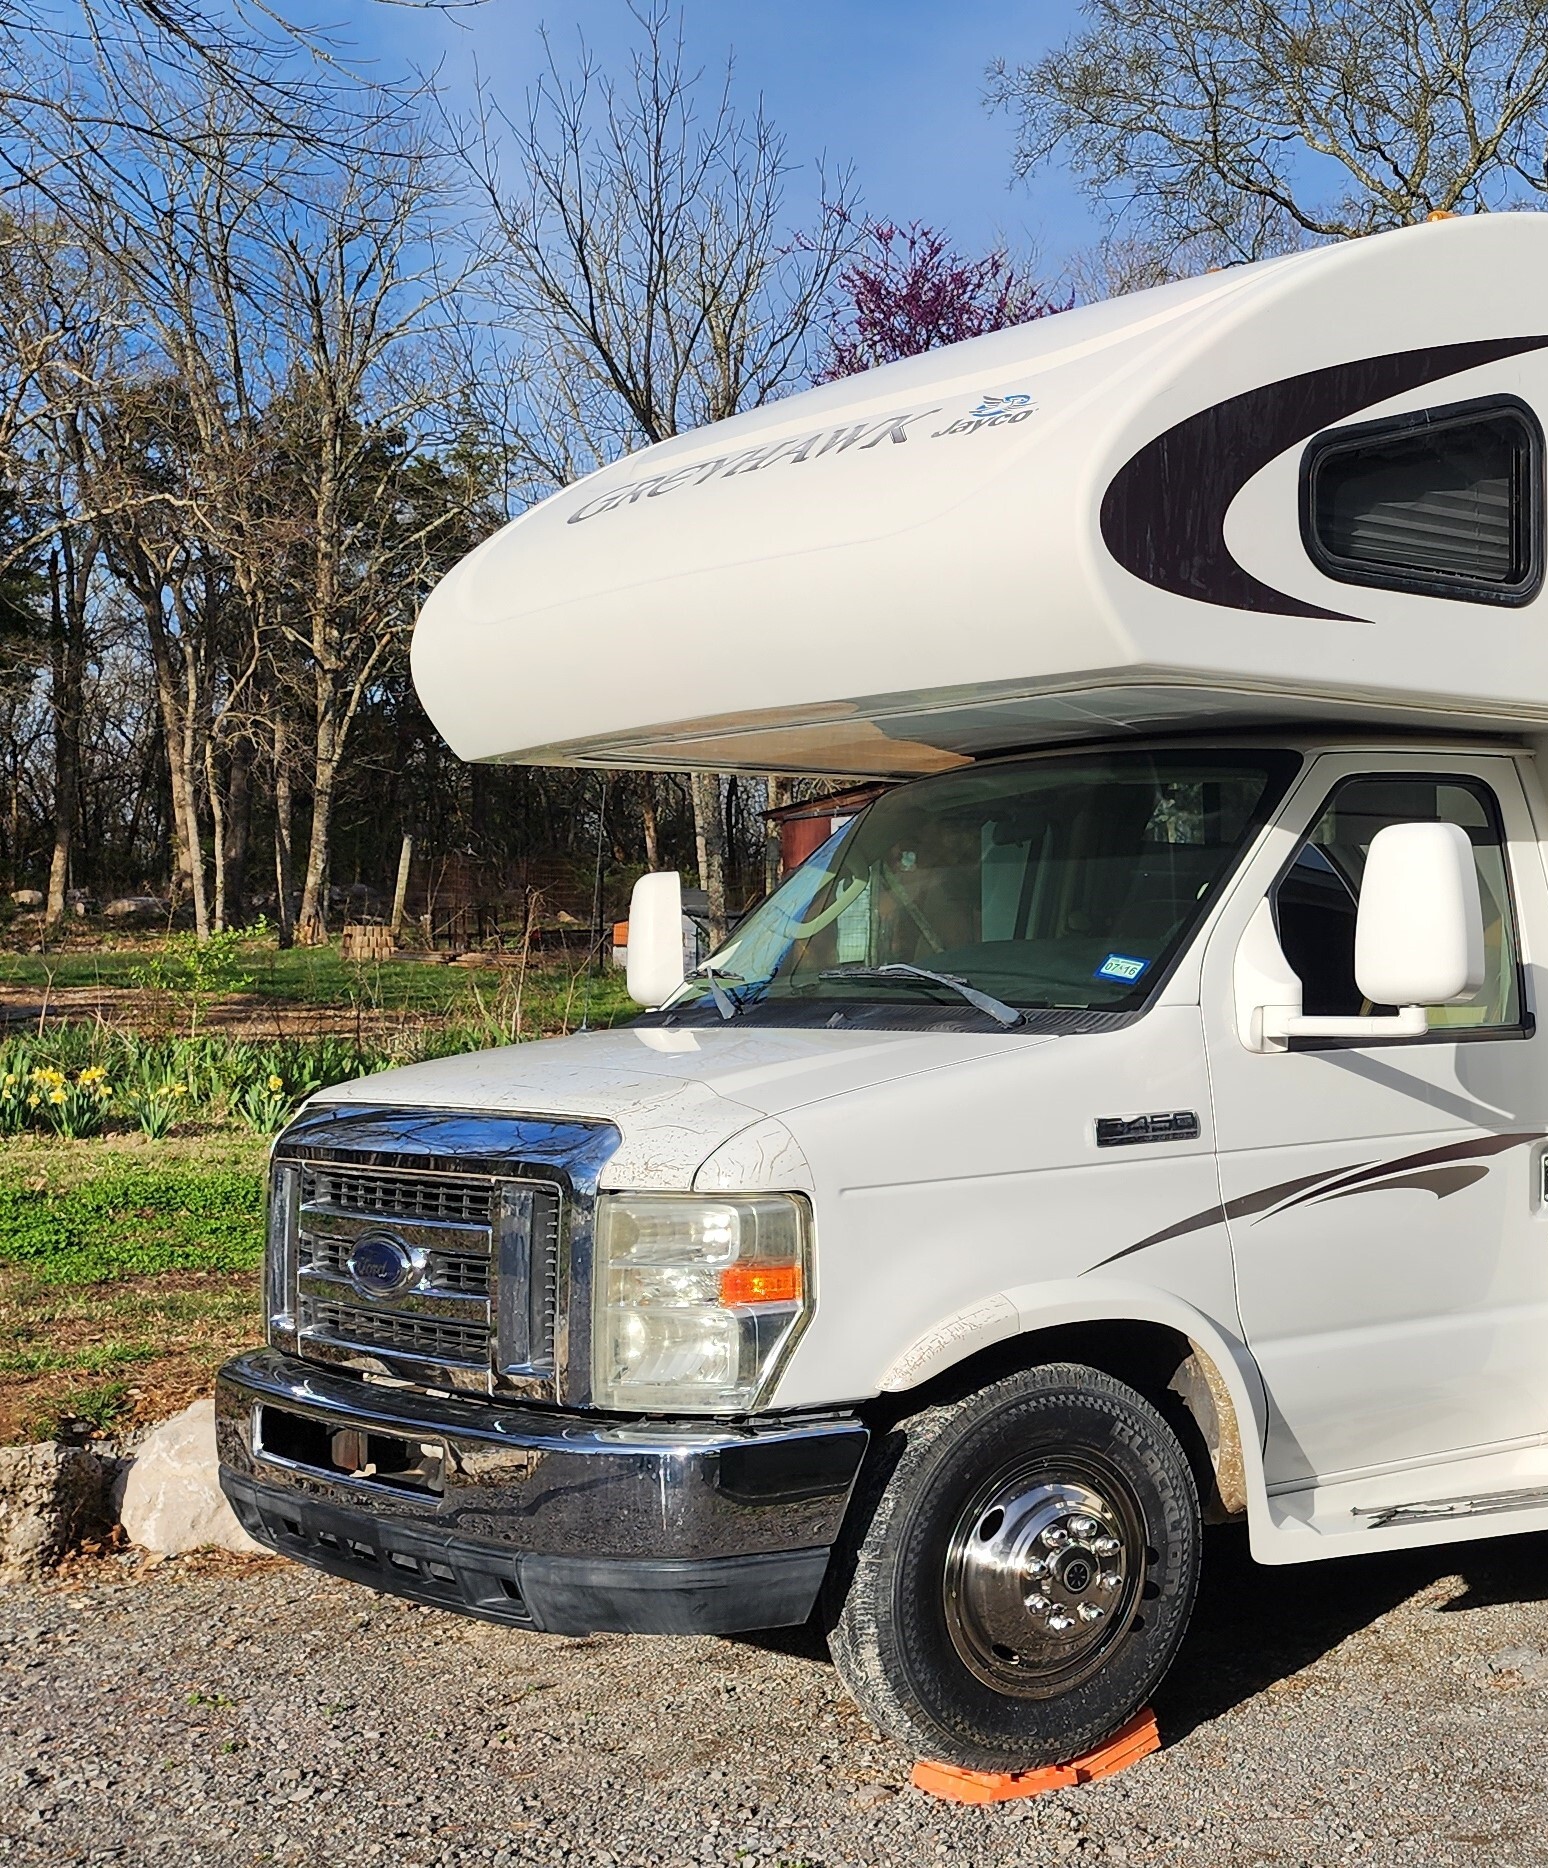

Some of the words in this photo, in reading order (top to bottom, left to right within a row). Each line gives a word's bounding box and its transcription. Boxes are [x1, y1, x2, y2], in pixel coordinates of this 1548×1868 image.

[930, 409, 1034, 438] Jayco
[566, 408, 943, 525] GREYHAWK
[359, 1257, 388, 1277] Ford
